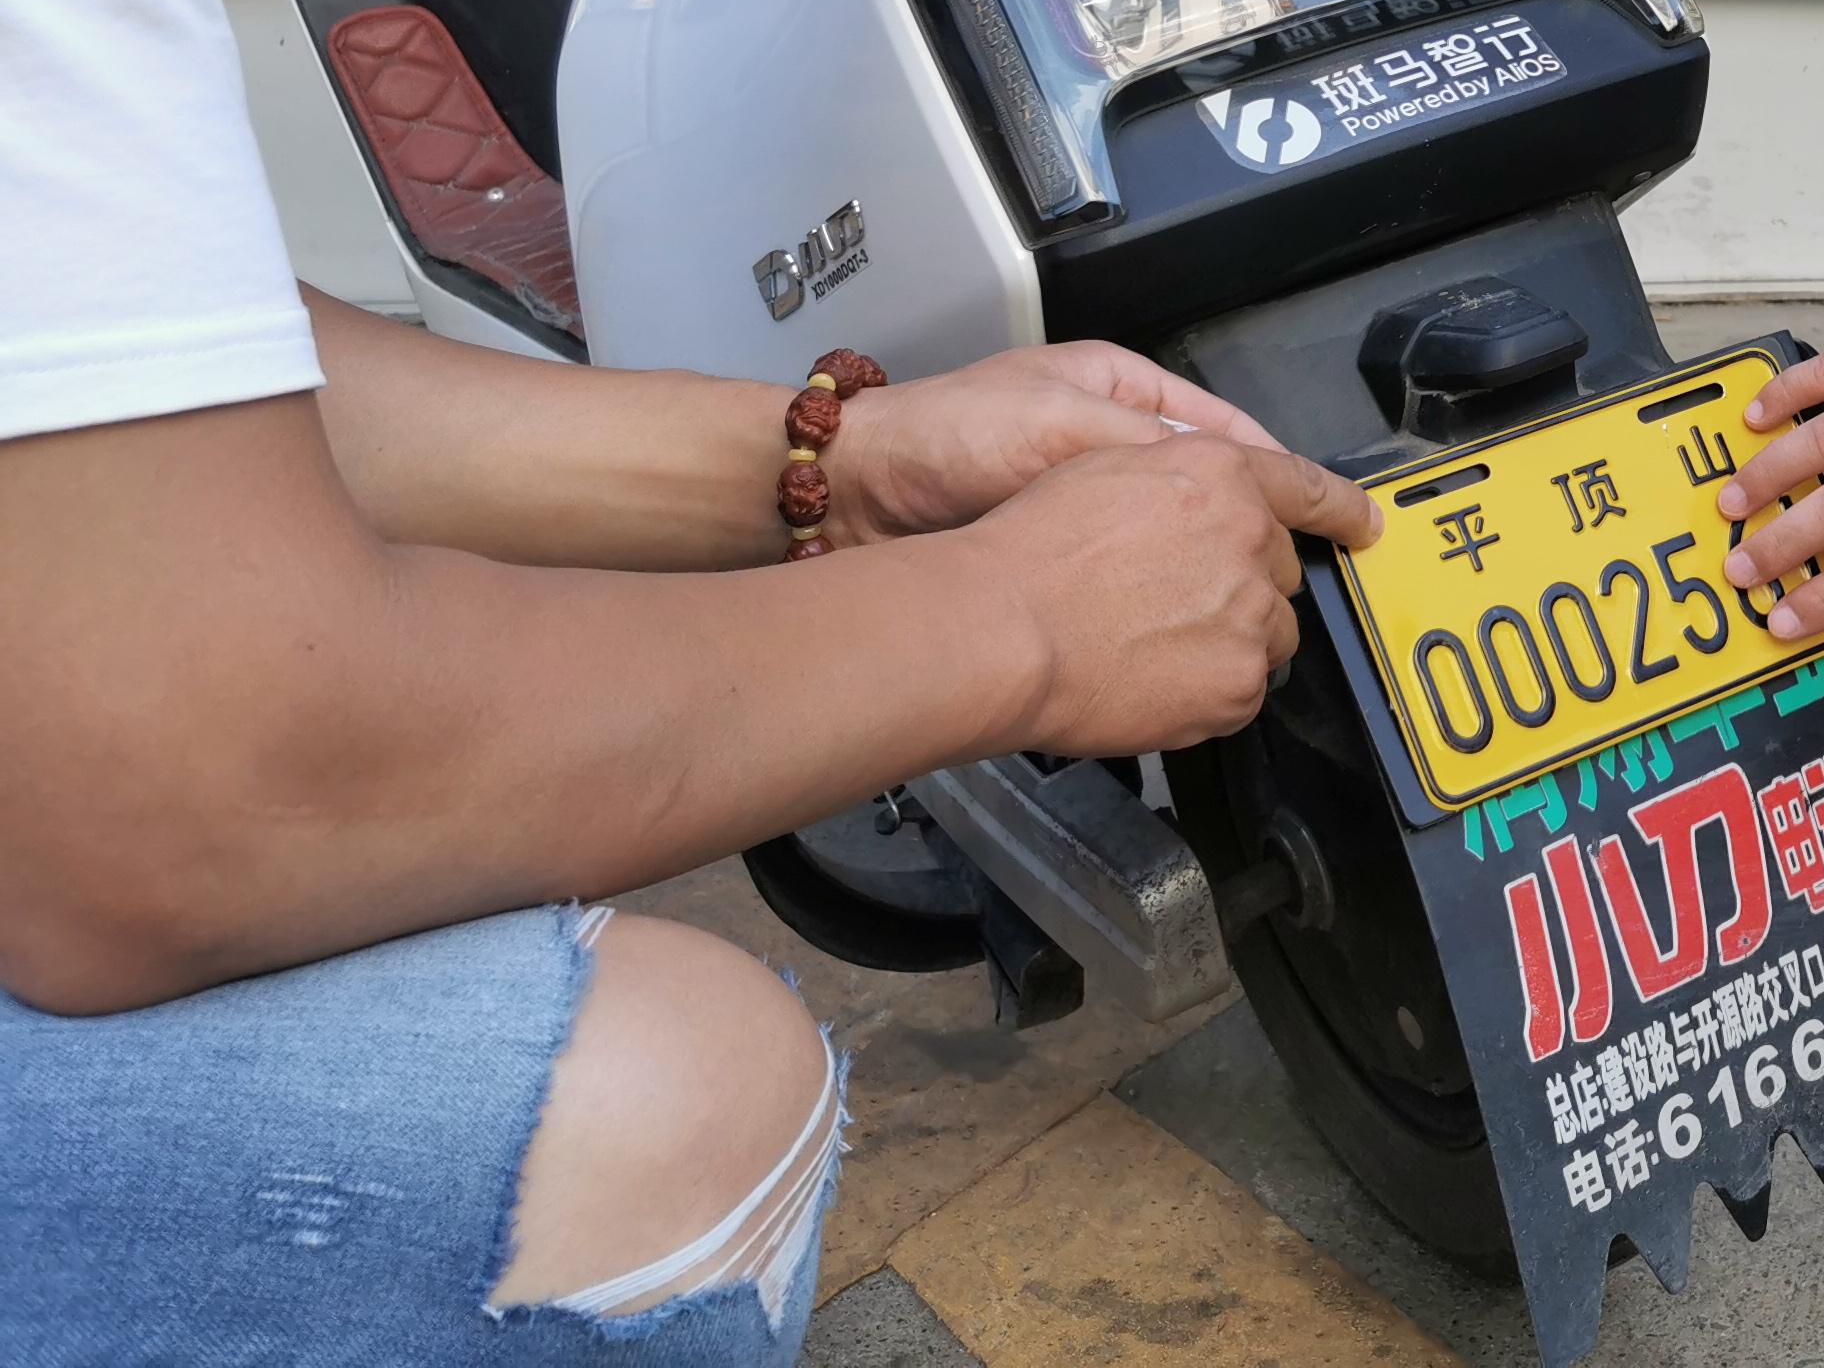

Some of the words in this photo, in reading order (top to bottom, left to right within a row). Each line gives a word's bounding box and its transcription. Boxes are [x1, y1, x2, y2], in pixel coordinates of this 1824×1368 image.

[1311, 16, 1538, 116] 斑马智行
[1340, 85, 1460, 136] Powered
[1495, 53, 1560, 88] AliOS
[811, 248, 869, 300] XD1000DQT-3
[1411, 495, 1823, 754] 00025
